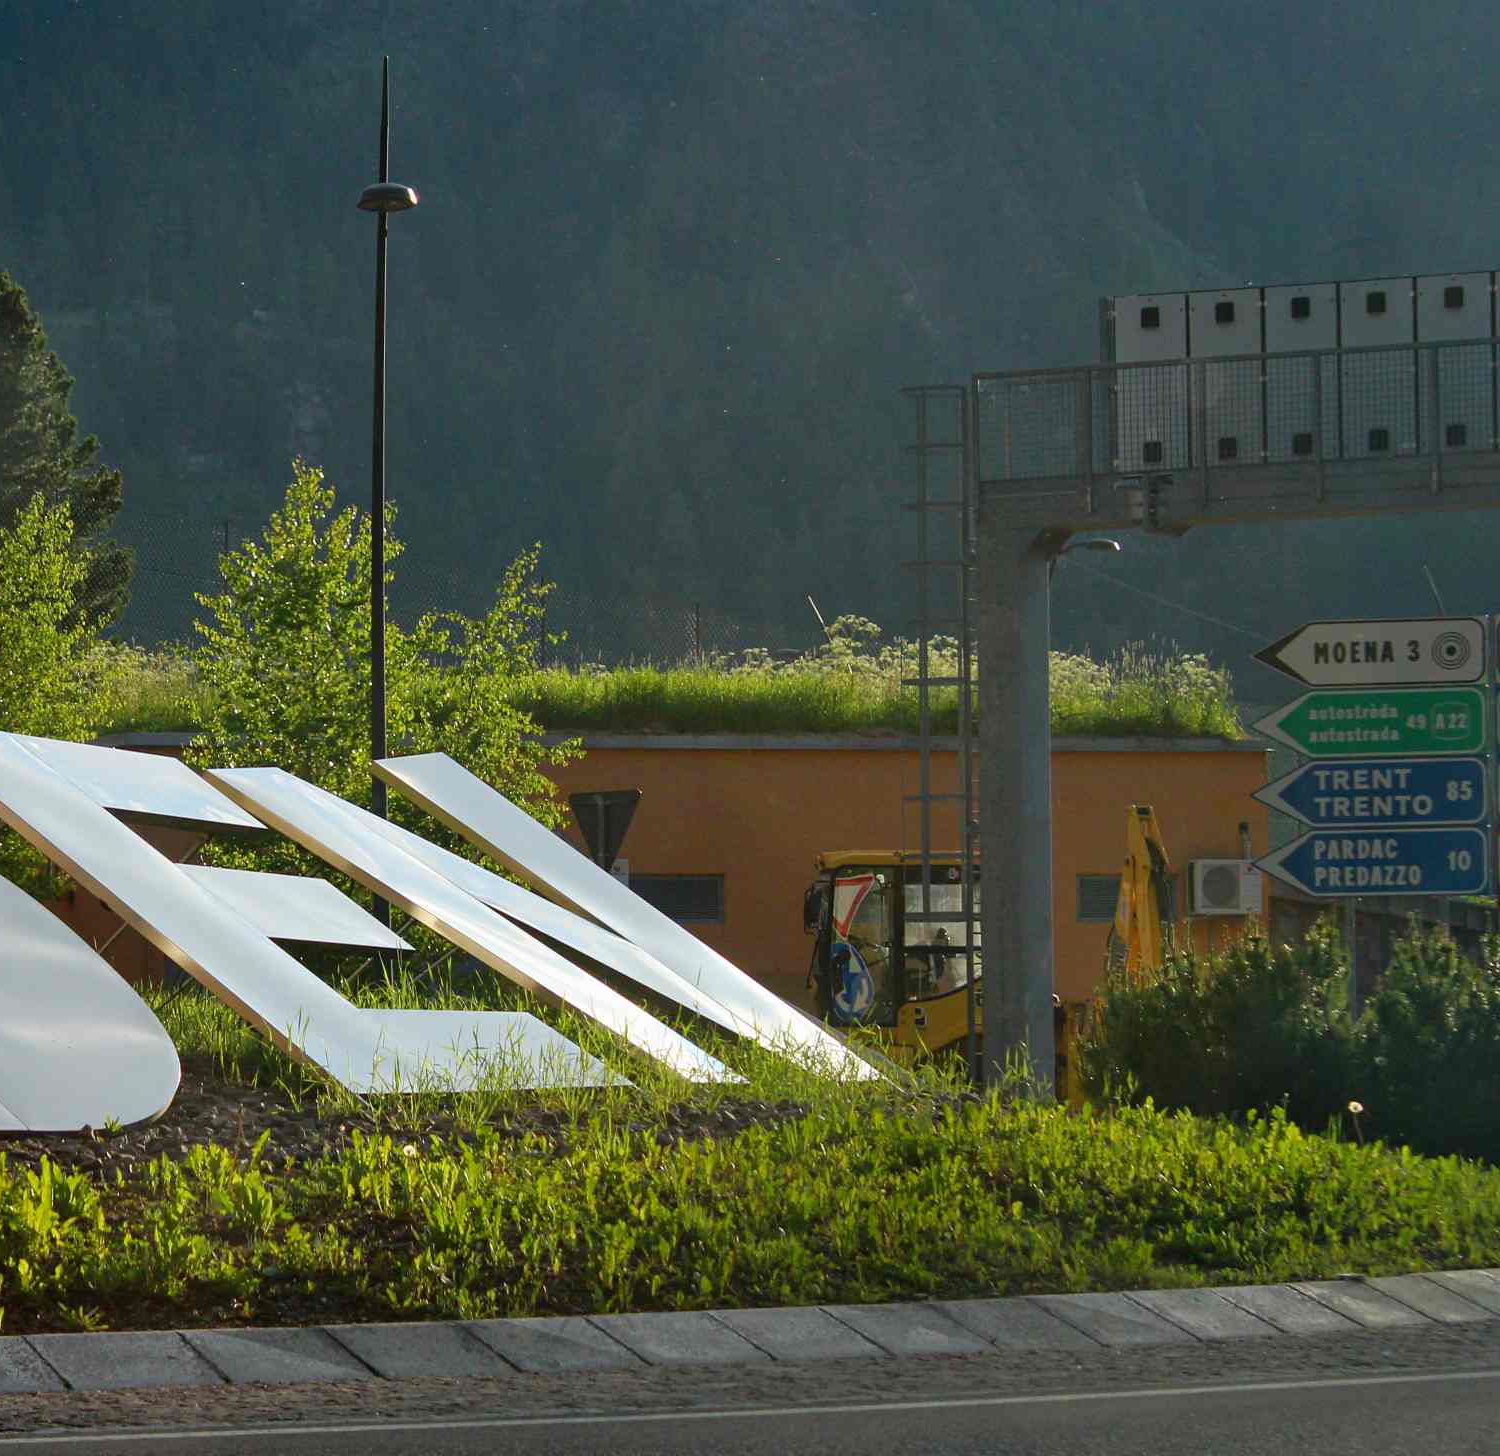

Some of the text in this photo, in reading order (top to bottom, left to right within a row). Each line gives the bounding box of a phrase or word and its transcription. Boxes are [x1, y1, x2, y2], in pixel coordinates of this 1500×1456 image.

[1313, 640, 1421, 664] MOENA 3
[1308, 726, 1400, 743] autostrada
[1314, 768, 1412, 790] TRENT
[1446, 780, 1472, 801] 85
[1314, 795, 1433, 816] TRENTO
[1314, 839, 1398, 860] PARDAC
[1447, 850, 1471, 870] 10
[1314, 865, 1422, 886] PREDAZZO
